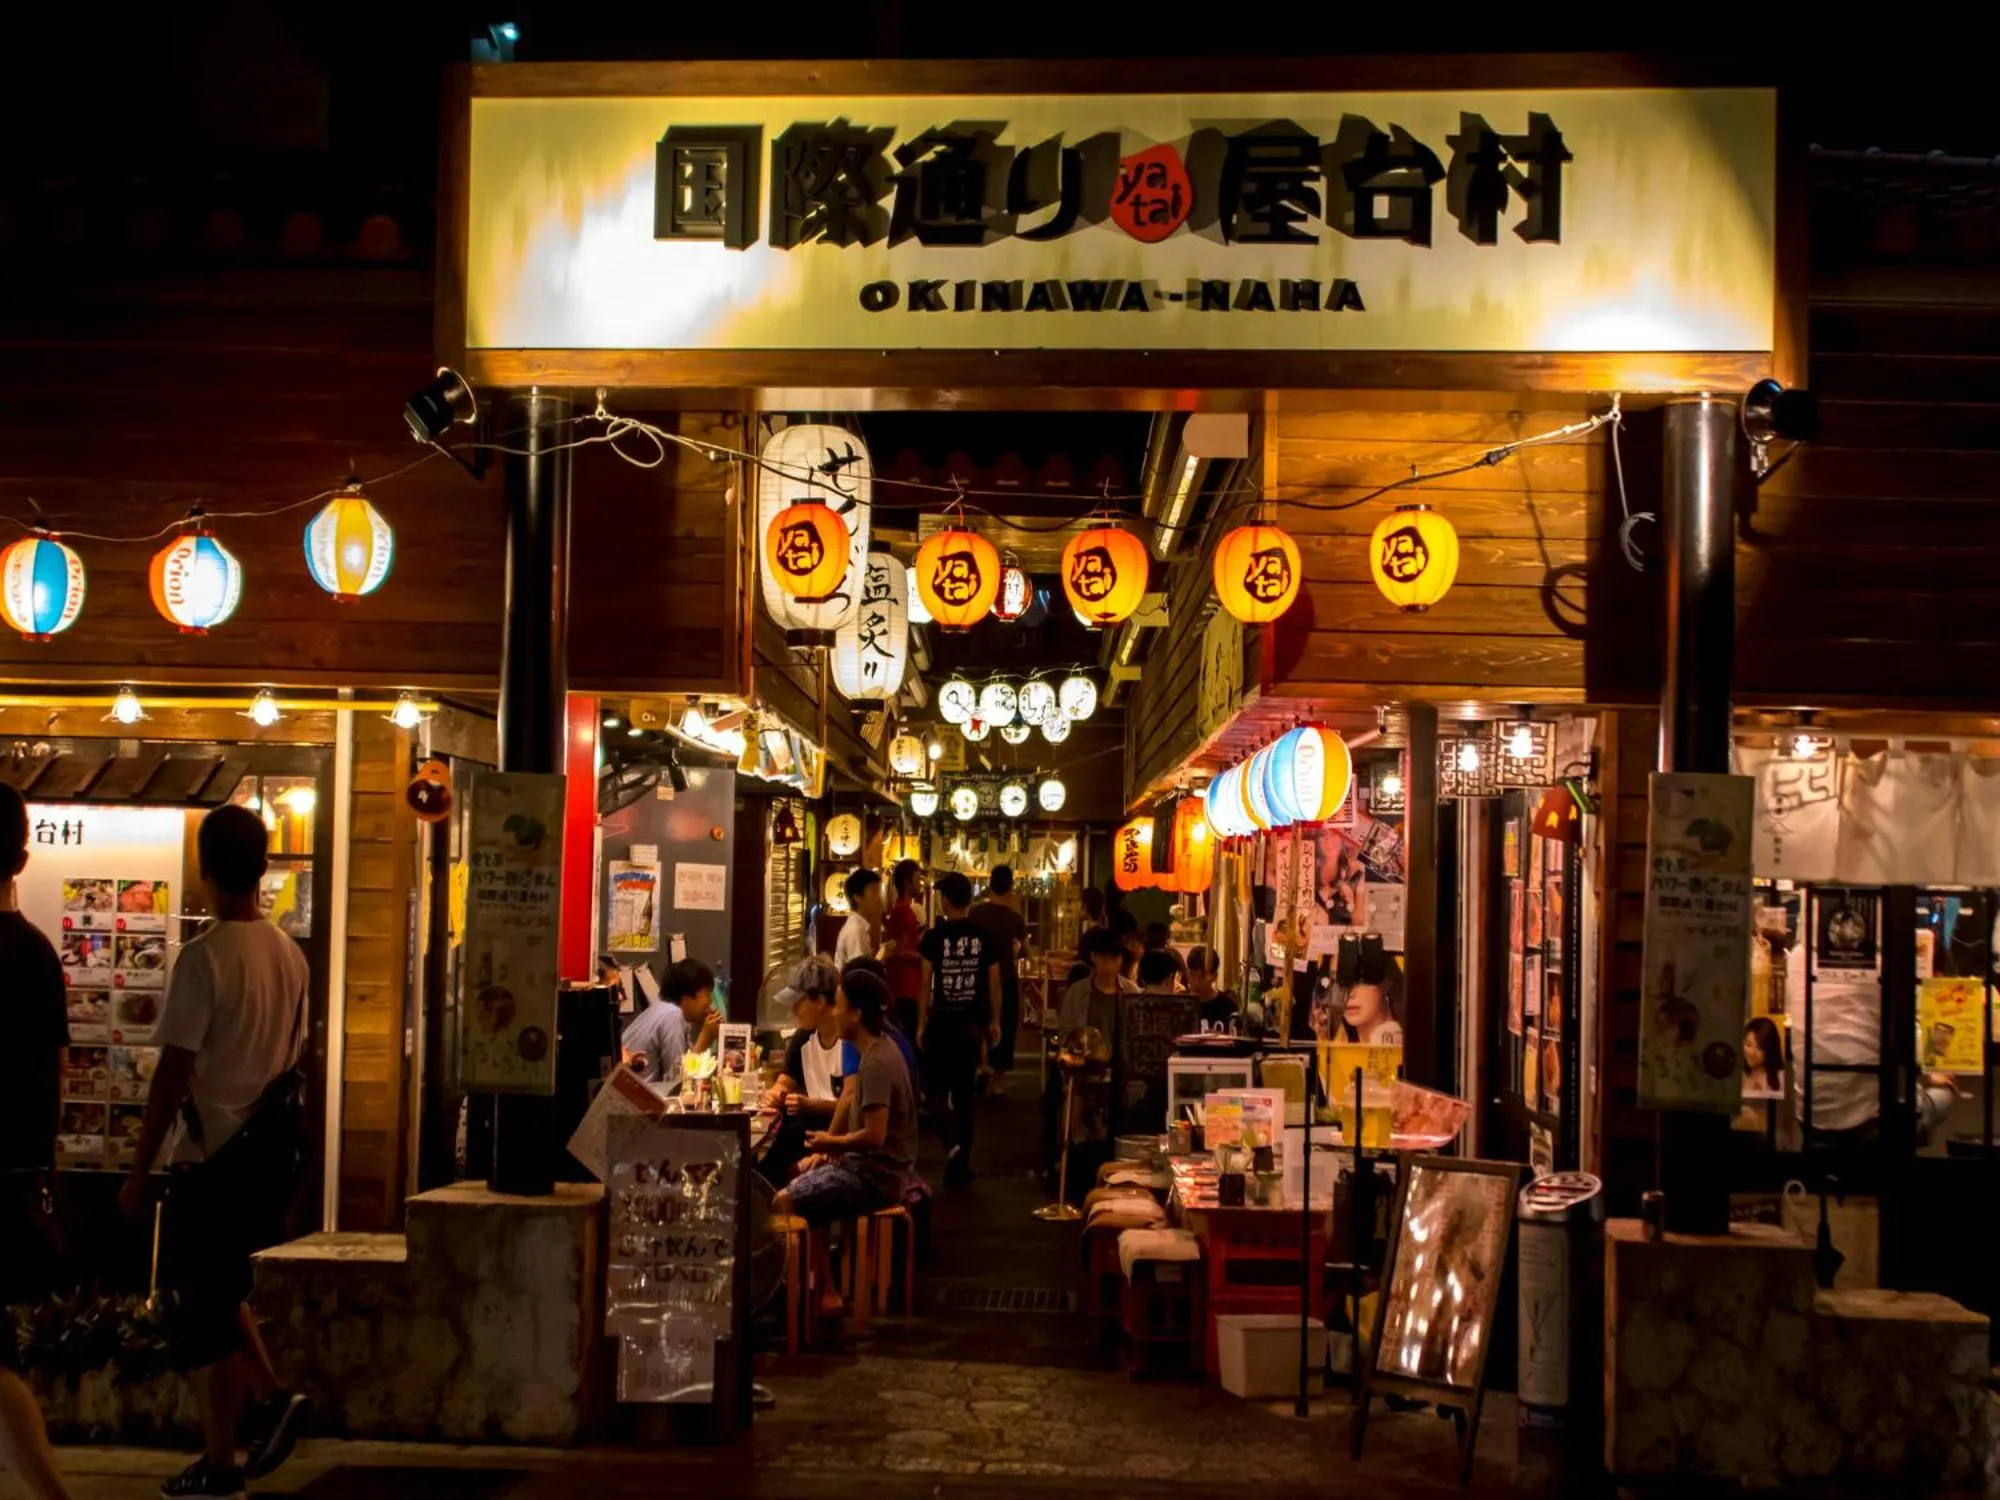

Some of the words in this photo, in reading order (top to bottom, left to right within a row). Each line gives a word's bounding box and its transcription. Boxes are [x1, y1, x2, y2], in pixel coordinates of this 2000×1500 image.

[1115, 160, 1168, 205] ya
[1133, 182, 1182, 227] tai
[779, 528, 810, 556] ya
[1382, 537, 1414, 565] ya
[785, 543, 820, 570] tai
[1073, 554, 1103, 581] ya
[1250, 556, 1281, 583] ya
[1390, 550, 1427, 578] tai
[167, 547, 192, 606] Orion
[934, 558, 970, 585] ya
[1077, 567, 1113, 596] tai
[1255, 569, 1291, 599] tai
[942, 575, 977, 601] tai
[35, 819, 84, 847] 台村
